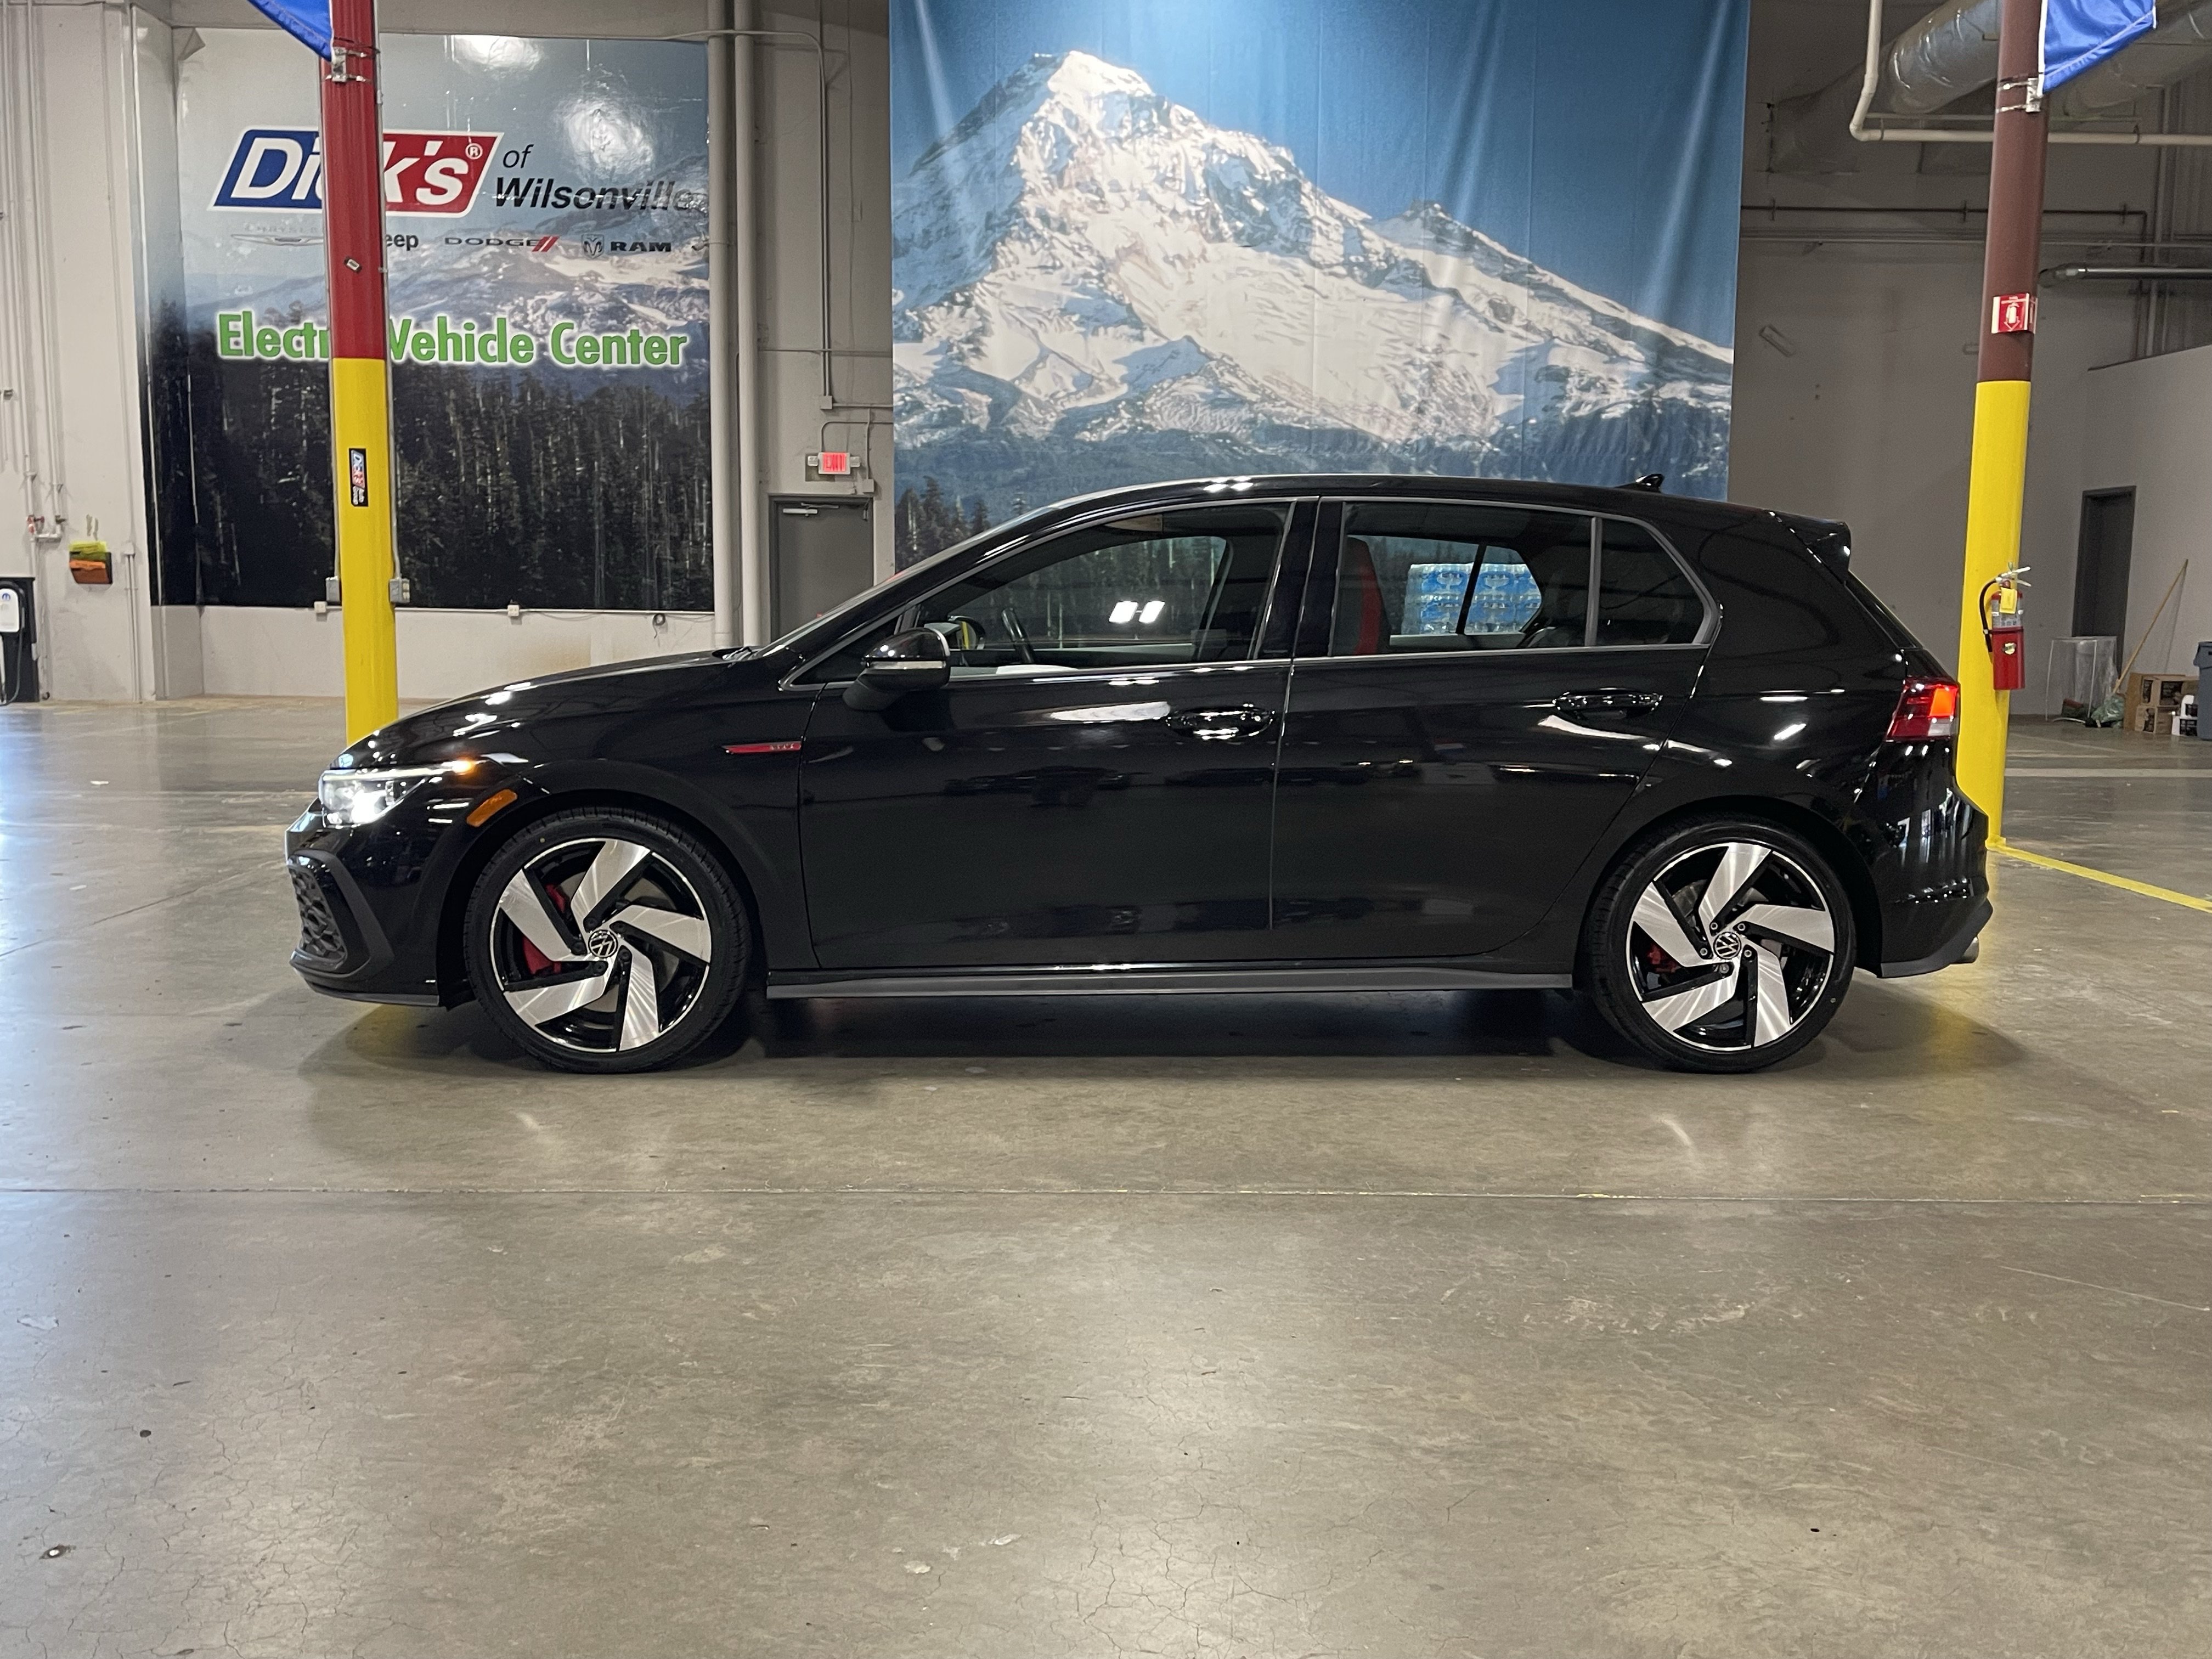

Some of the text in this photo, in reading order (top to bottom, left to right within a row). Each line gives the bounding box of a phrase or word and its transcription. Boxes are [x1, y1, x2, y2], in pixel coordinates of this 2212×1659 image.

[503, 144, 534, 169] of
[230, 137, 469, 205] Dik's
[496, 177, 693, 212] Wilsonville
[386, 234, 419, 251] eep
[444, 237, 540, 247] DODGE
[611, 241, 672, 252] RAM
[219, 311, 687, 365] Electr Vehicle Center
